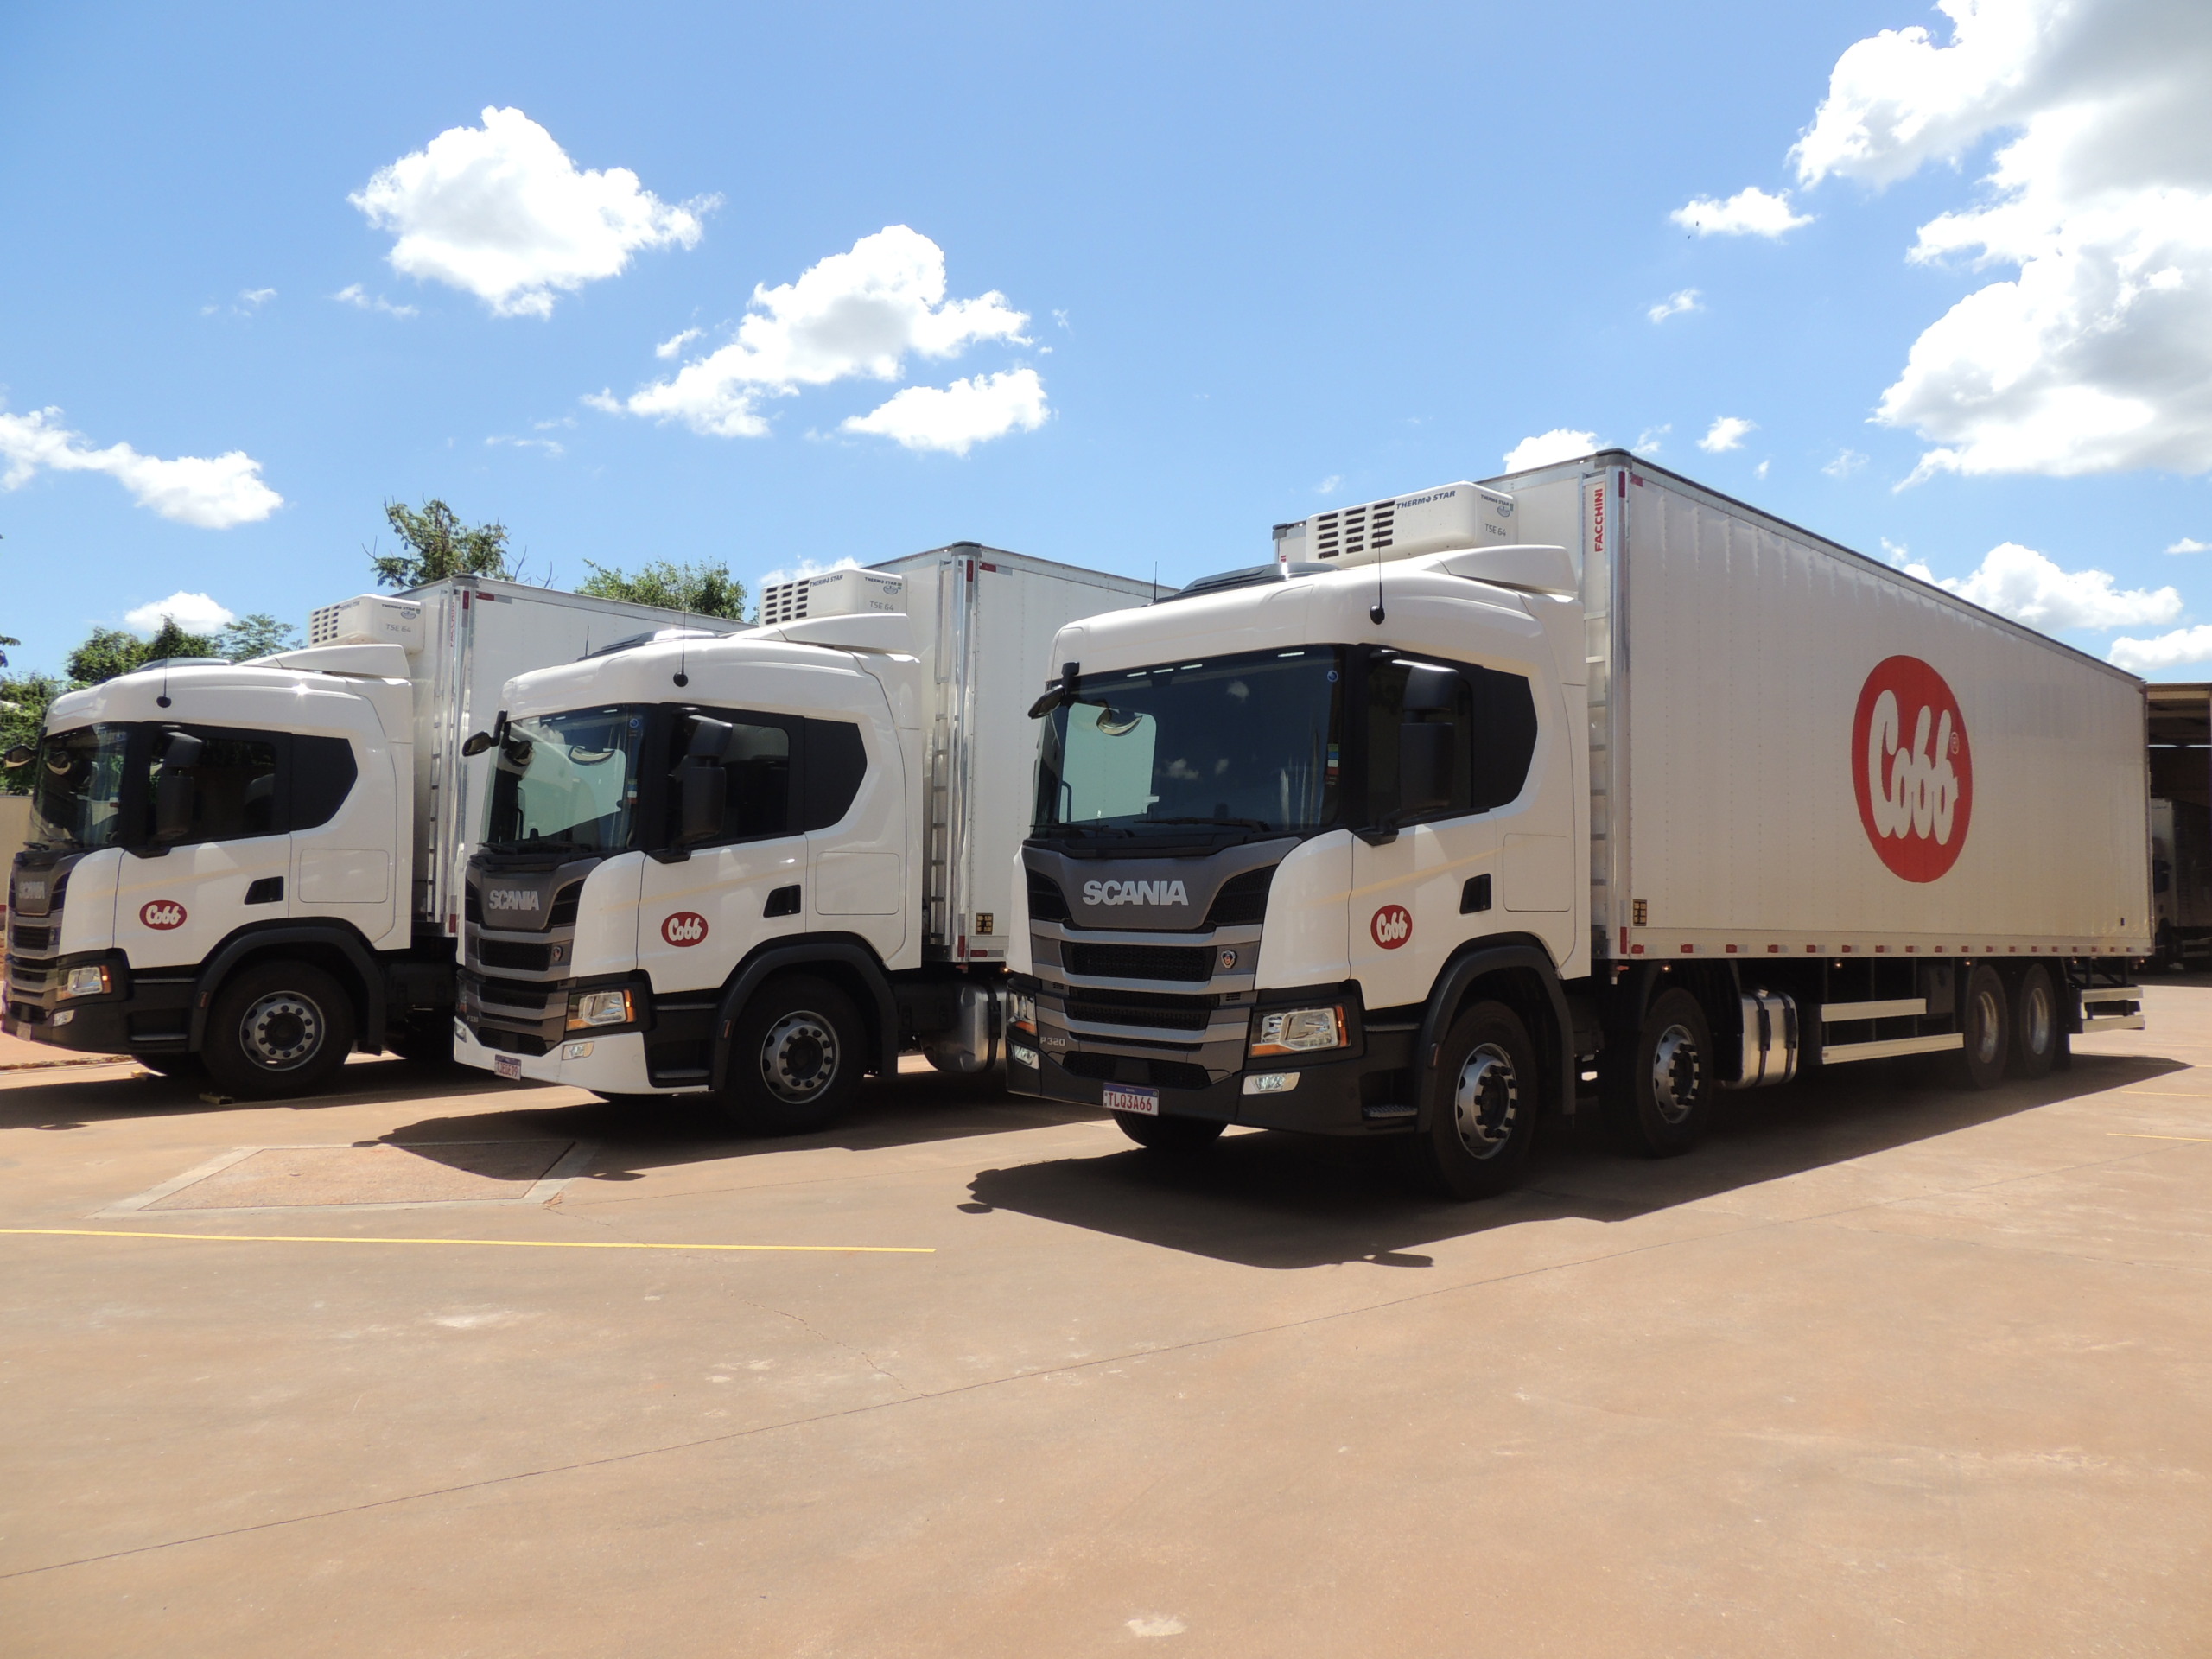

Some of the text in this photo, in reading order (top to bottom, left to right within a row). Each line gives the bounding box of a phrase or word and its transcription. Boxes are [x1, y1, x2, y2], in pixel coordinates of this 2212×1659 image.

[1396, 491, 1456, 509] THERMO STAR
[1485, 523, 1506, 537] TSE 64
[830, 574, 843, 582] STAR
[870, 601, 894, 612] TSE 64
[386, 623, 400, 632] TSE
[489, 889, 539, 910] SCANIA
[1083, 880, 1189, 906] SCANIA
[146, 904, 181, 925] Cobb
[668, 917, 703, 942] Cobb
[1376, 910, 1408, 943] Cobb
[1047, 1037, 1065, 1046] 320
[1109, 1092, 1152, 1112] TLQ3A66
